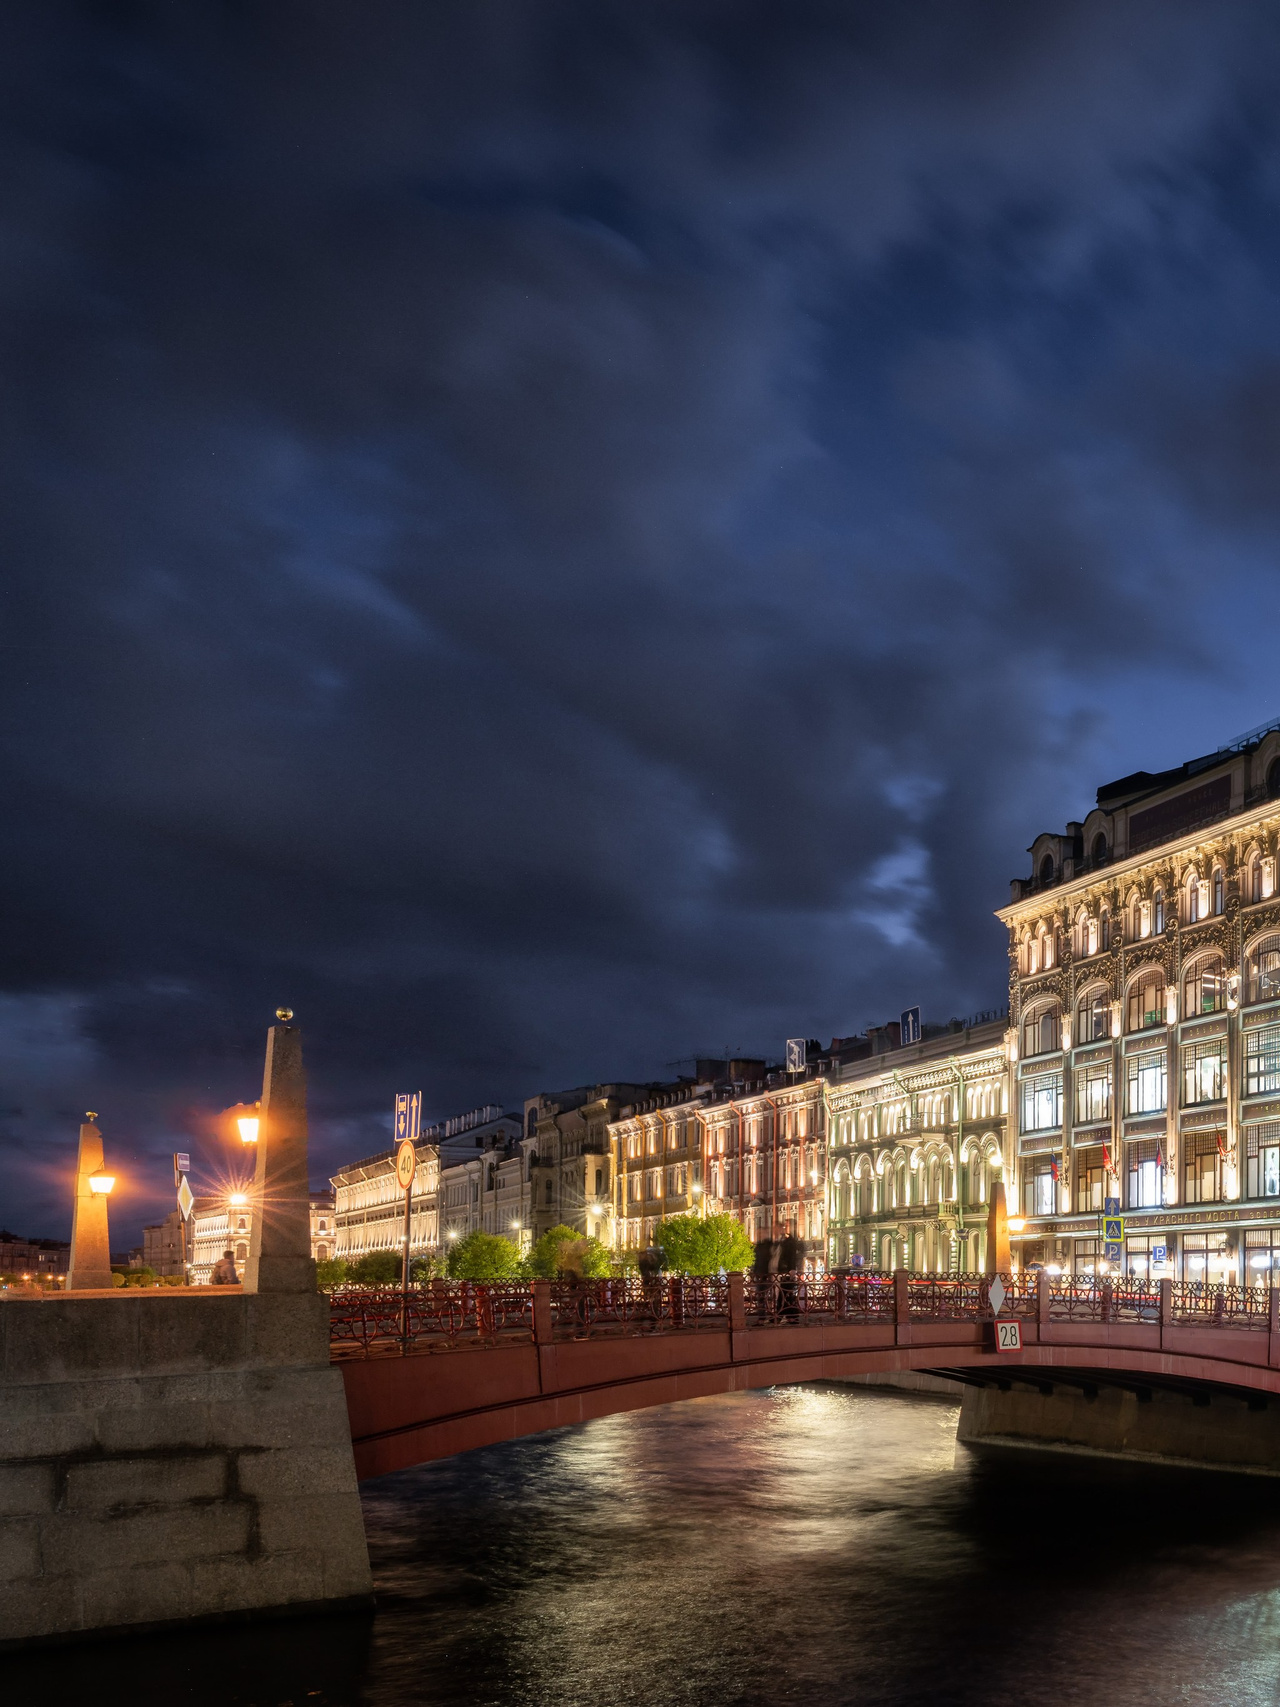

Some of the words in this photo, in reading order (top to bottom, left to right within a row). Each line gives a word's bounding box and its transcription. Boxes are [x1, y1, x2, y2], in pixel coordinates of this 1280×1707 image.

[401, 1155, 411, 1174] 40
[1153, 1213, 1201, 1226] КРАСНАГО
[1206, 1210, 1240, 1222] МОСТА
[1156, 1248, 1164, 1259] P
[1000, 1325, 1018, 1346] 2.8
